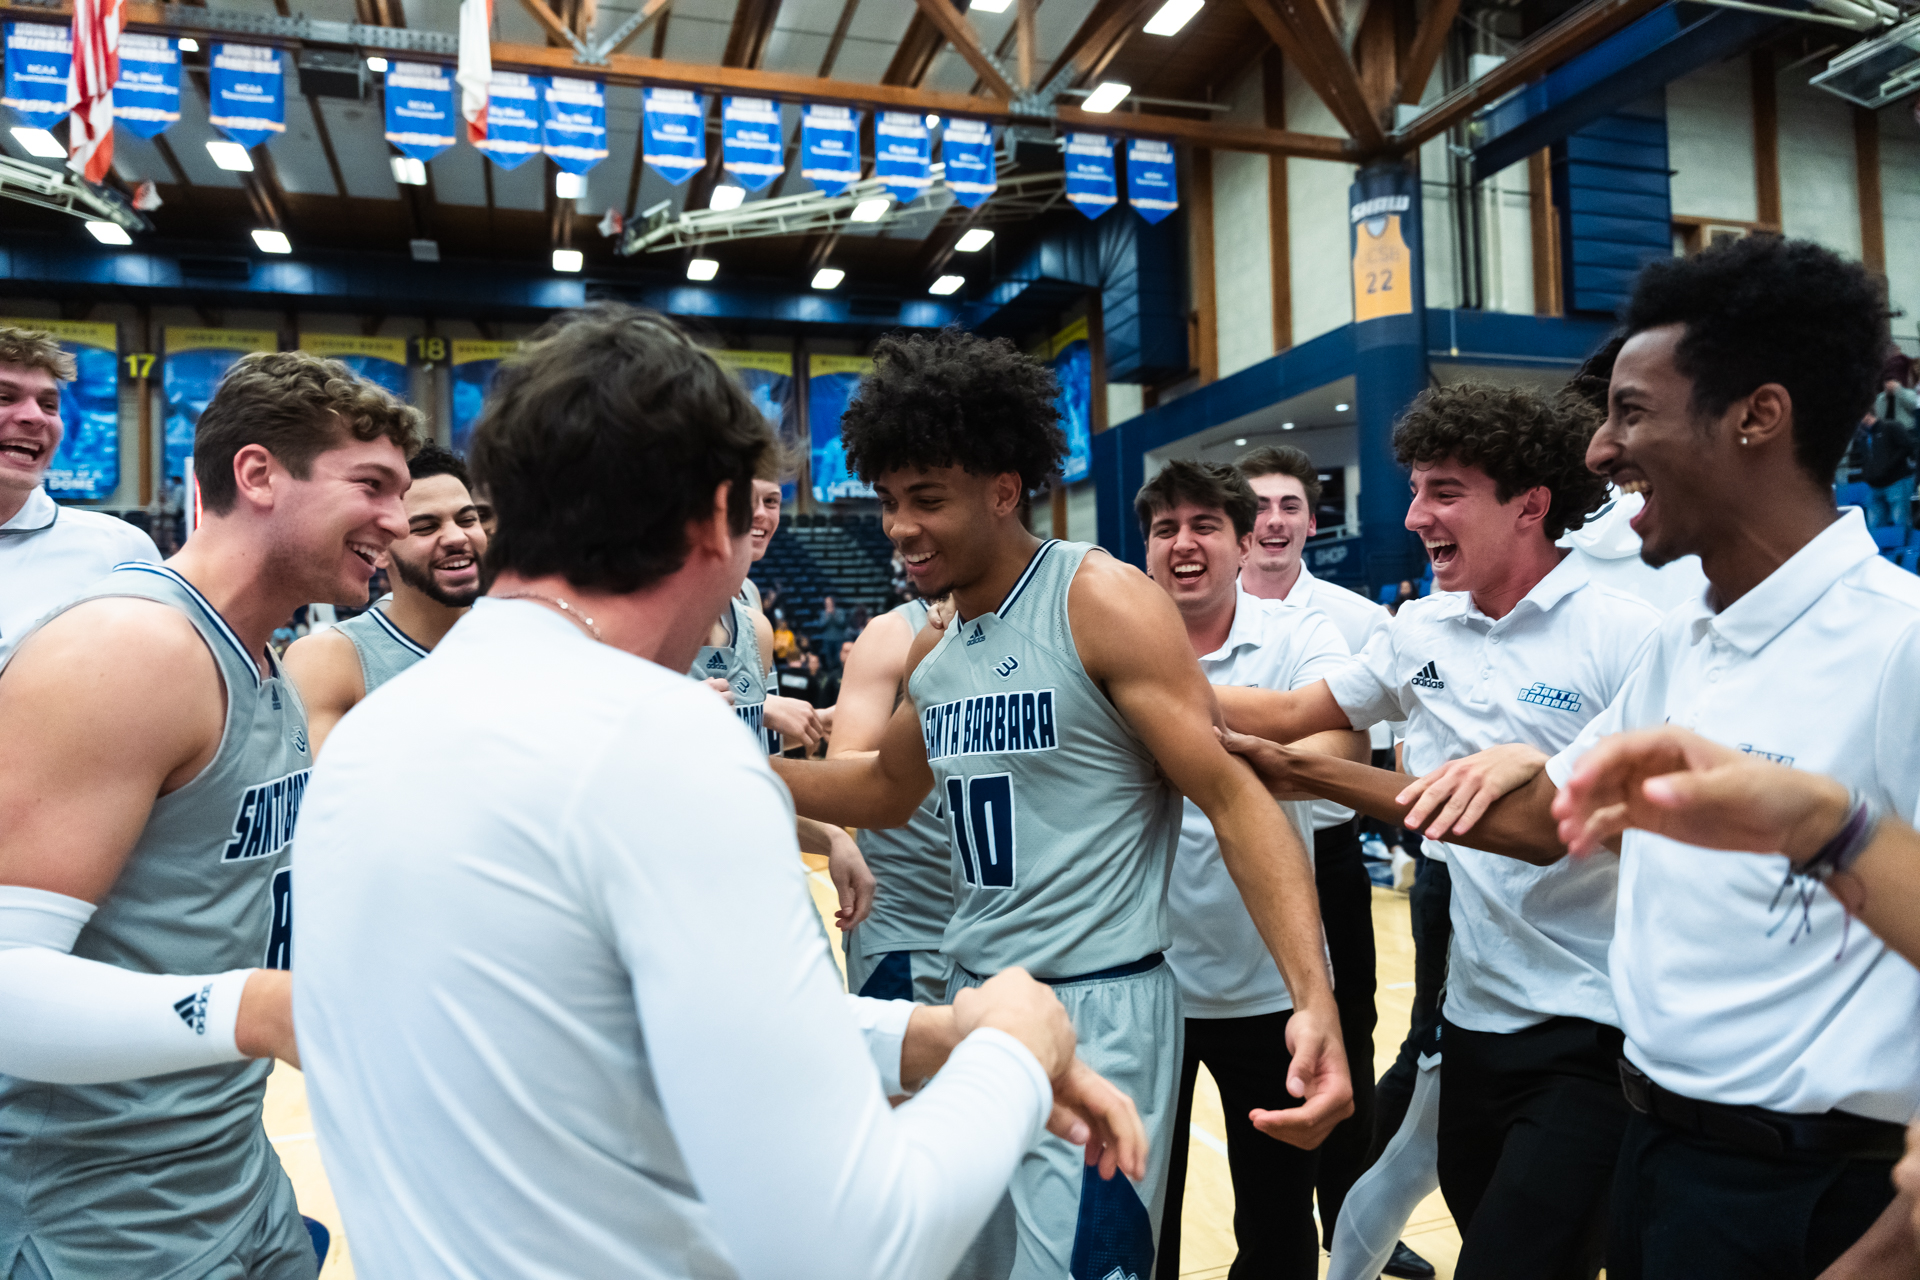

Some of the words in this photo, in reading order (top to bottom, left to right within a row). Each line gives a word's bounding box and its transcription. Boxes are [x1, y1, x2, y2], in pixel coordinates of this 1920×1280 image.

[1366, 269, 1393, 294] 22
[418, 337, 446, 361] 18
[126, 354, 157, 378] 17
[966, 634, 987, 647] adidas
[706, 661, 728, 672] adidas
[1411, 675, 1445, 690] adidas
[1529, 682, 1580, 703] SANTA
[1517, 688, 1582, 712] BARBARA
[961, 689, 1057, 756] BARBARA
[945, 771, 1016, 889] 10
